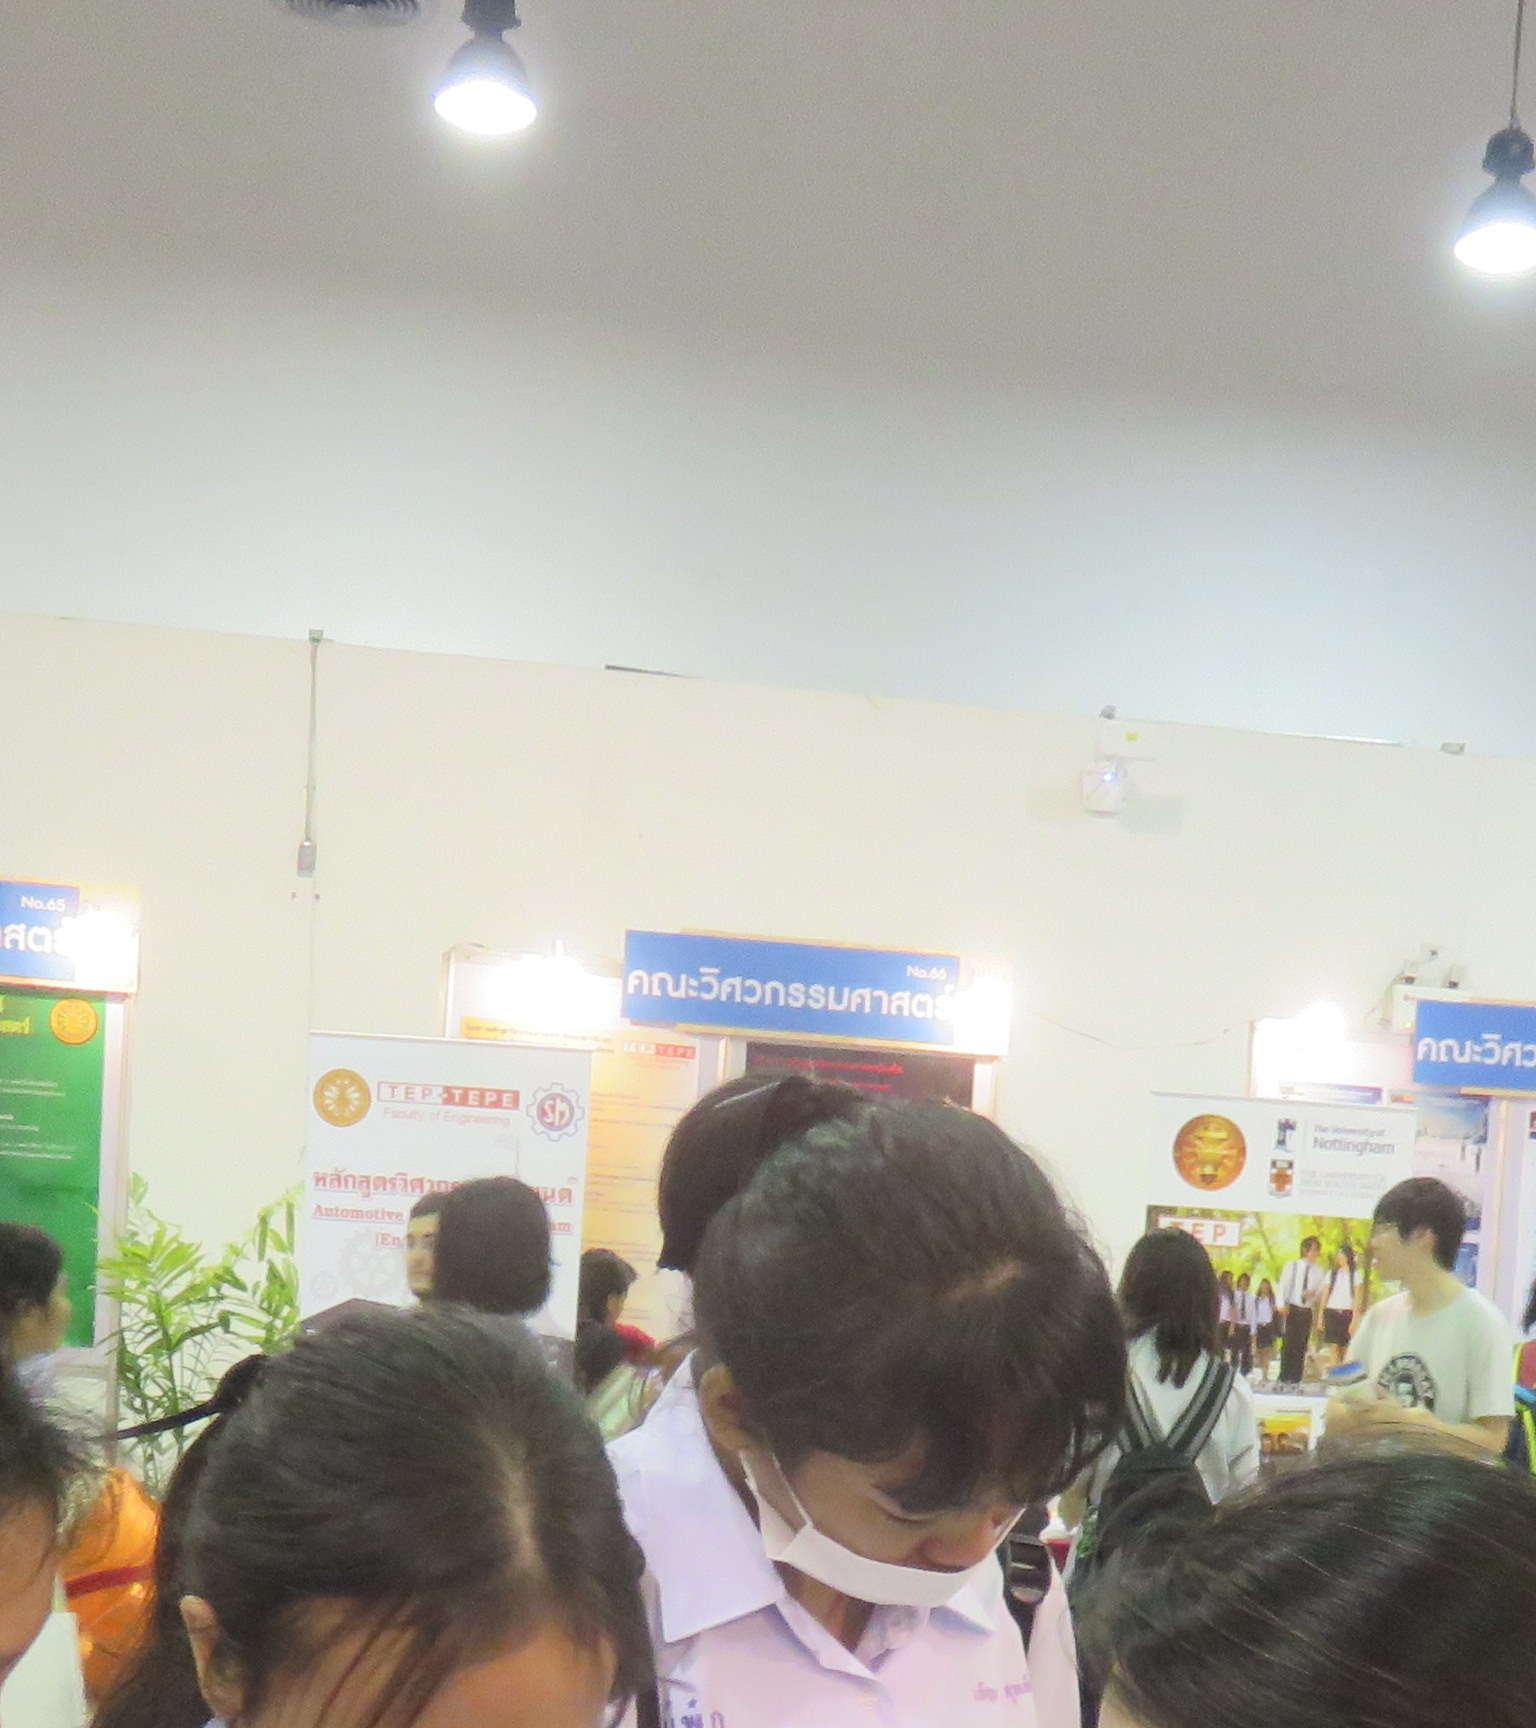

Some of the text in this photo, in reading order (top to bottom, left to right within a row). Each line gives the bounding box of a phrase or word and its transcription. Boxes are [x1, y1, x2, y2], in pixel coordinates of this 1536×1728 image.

[19, 895, 66, 912] No.65
[905, 965, 947, 981] No.66
[453, 1089, 514, 1108] TEPE
[1313, 1136, 1396, 1157] Nottingham
[313, 1204, 404, 1222] Automotive
